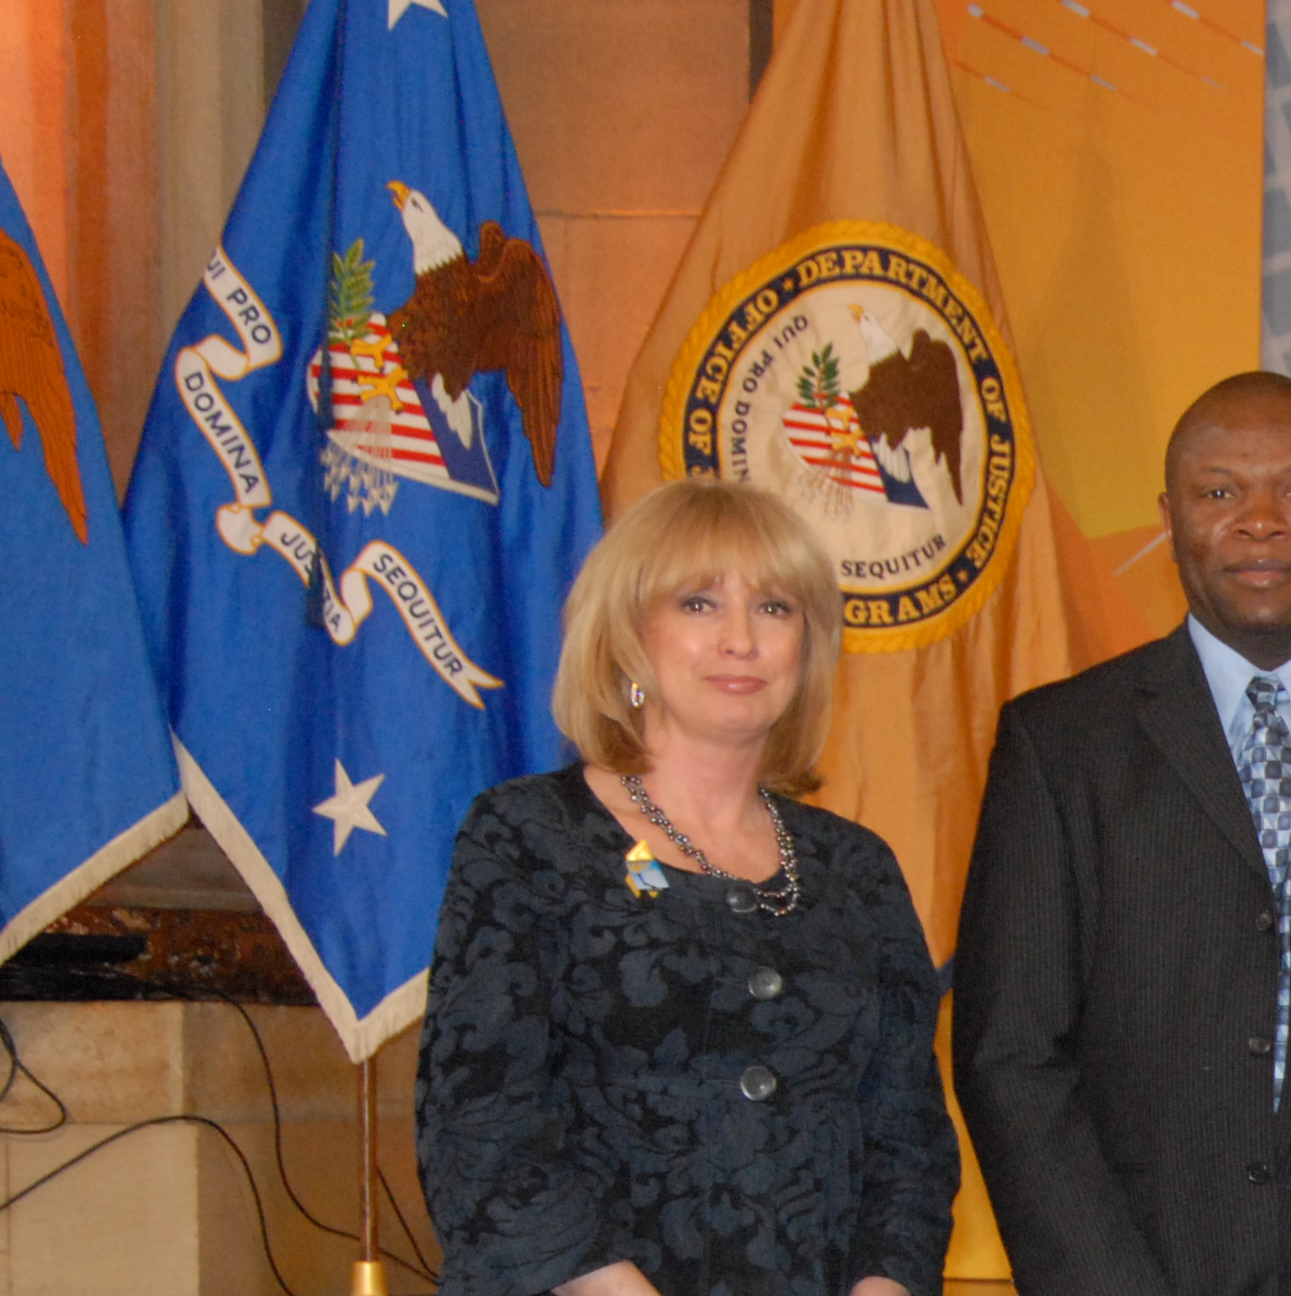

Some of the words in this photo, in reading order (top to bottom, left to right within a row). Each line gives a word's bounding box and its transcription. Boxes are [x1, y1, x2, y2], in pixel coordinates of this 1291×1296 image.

[207, 257, 227, 281] UI
[227, 287, 271, 345] PRO
[773, 313, 809, 350] QUI
[796, 249, 988, 363] DEPARTMENT
[695, 288, 779, 403] OFFICE
[742, 349, 774, 394] PRO
[981, 377, 1006, 422] OF
[184, 371, 259, 494] DOMINA
[688, 408, 713, 456] OF
[730, 400, 751, 483] DOMIN
[965, 433, 1013, 569] JUSTICE
[840, 533, 947, 580] SEQUITUR
[373, 553, 463, 676] SEQUITUR
[843, 573, 957, 624] GRAMS
